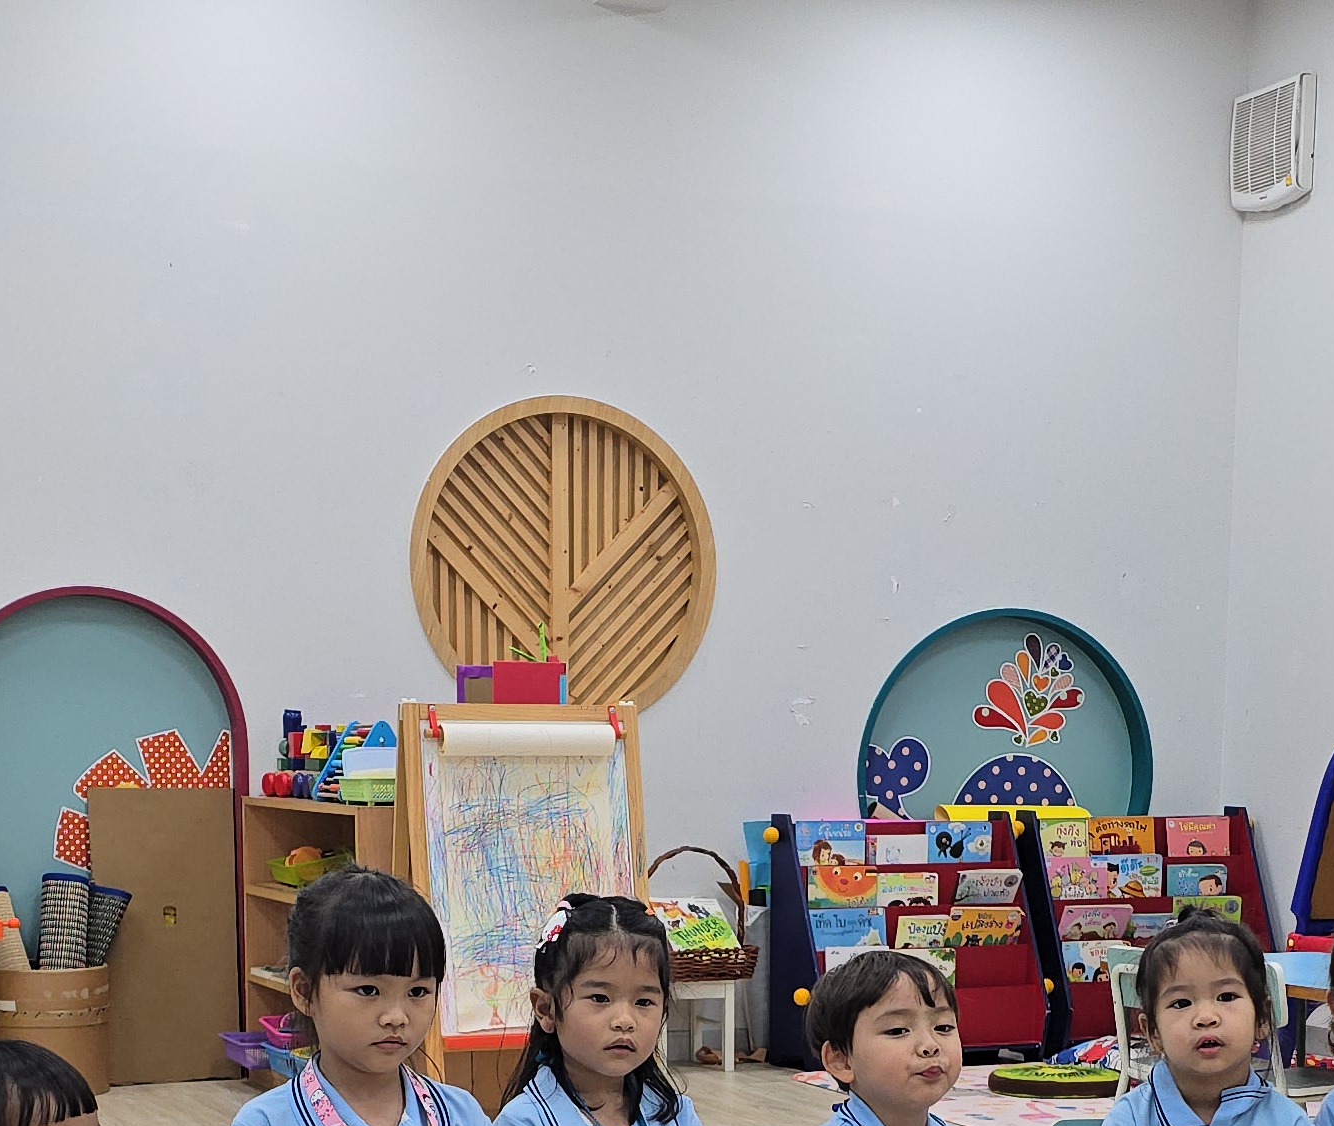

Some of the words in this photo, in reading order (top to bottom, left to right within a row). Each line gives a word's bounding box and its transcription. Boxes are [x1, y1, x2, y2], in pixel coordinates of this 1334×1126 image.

[1095, 820, 1148, 834] ต่อทางรถไฟ
[673, 918, 719, 940] THUNDER
